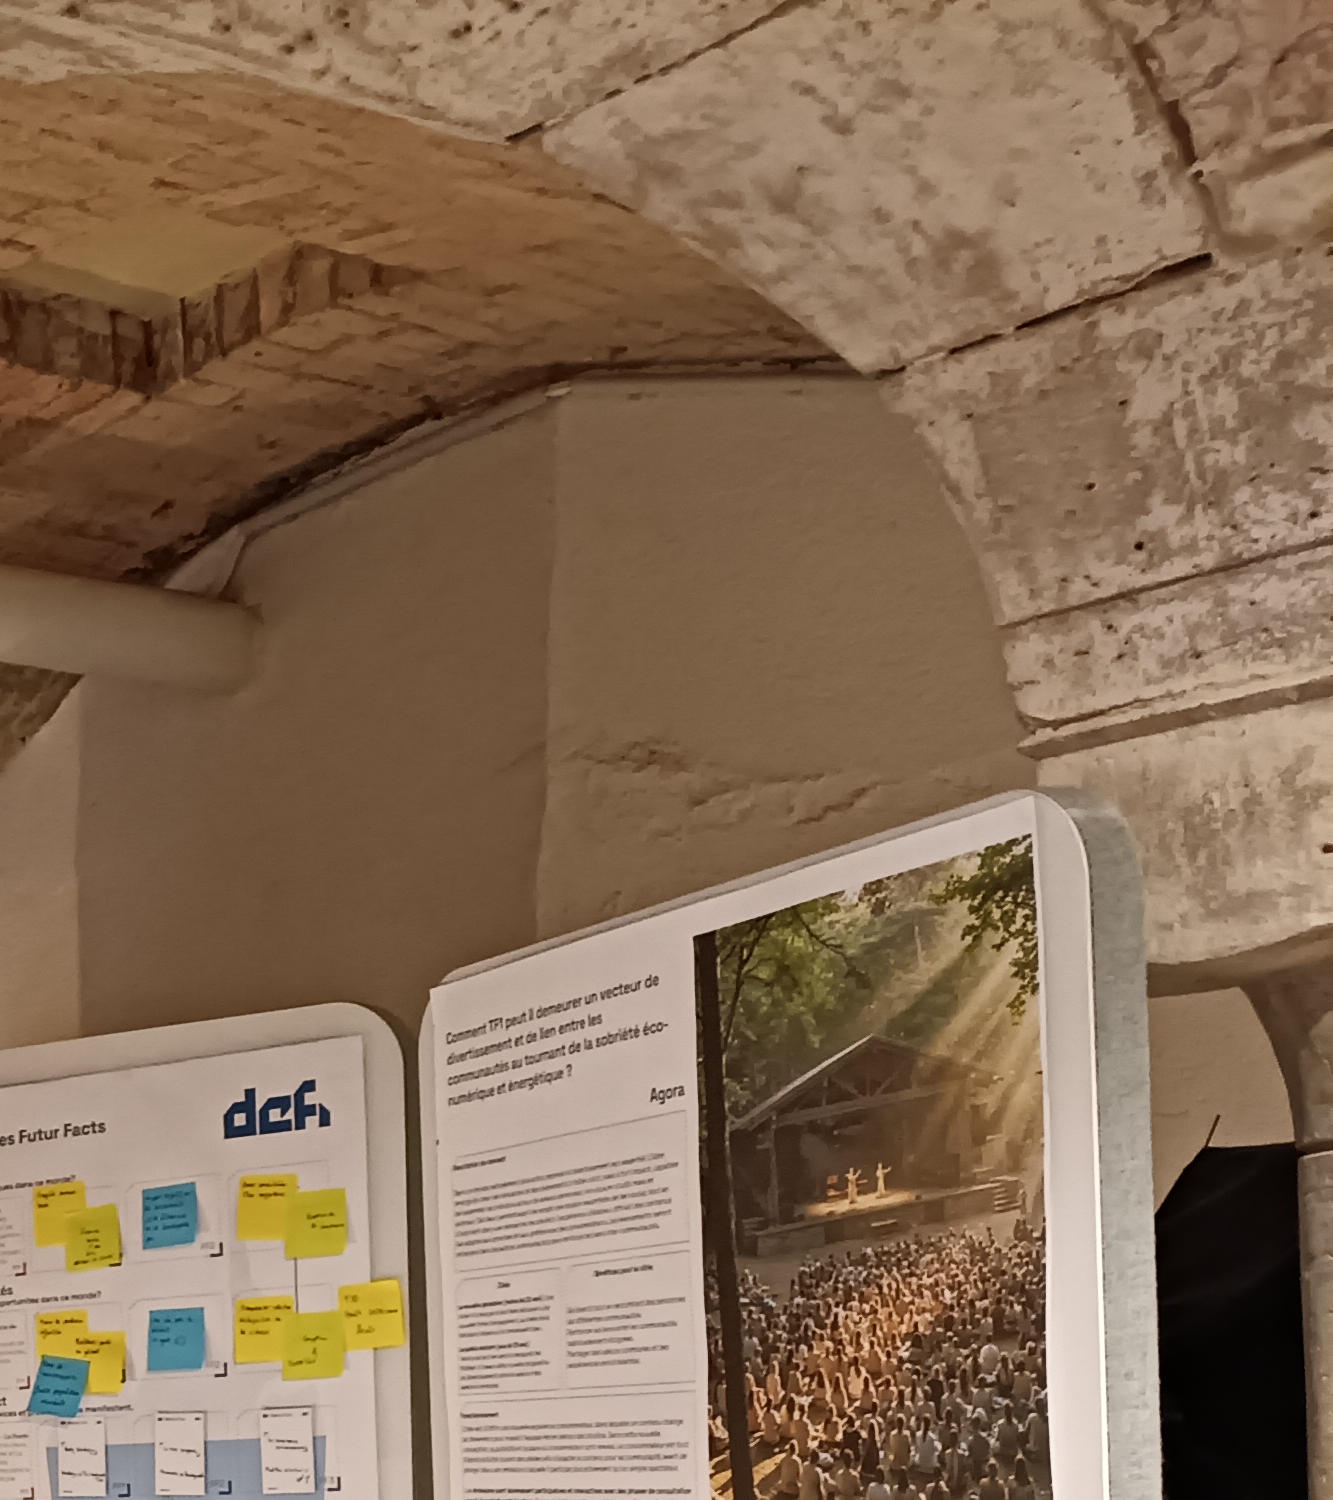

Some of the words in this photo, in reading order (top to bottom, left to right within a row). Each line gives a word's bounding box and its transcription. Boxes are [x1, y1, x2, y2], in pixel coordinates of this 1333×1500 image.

[446, 1023, 487, 1045] Comment
[505, 1011, 527, 1031] peut
[536, 997, 582, 1019] demeurer
[584, 993, 598, 1005] un
[599, 980, 642, 1000] vecteur
[644, 974, 660, 989] de
[514, 1035, 524, 1047] et
[526, 1031, 537, 1044] de
[539, 1026, 556, 1040] lien
[558, 1018, 586, 1035] entre
[588, 1013, 603, 1027] les
[448, 1060, 510, 1086] communautés
[511, 1059, 523, 1070] au
[524, 1045, 566, 1066] tournant
[568, 1040, 581, 1055] de
[583, 1038, 593, 1050] la
[595, 1024, 641, 1048] sobriété
[643, 1021, 669, 1036] éco-
[448, 1086, 495, 1106] numérique
[497, 1083, 507, 1095] et
[508, 1069, 564, 1091] énergétique
[566, 1063, 573, 1077] ?
[649, 1085, 686, 1105] Agora
[18, 1127, 60, 1144] Futur
[63, 1120, 107, 1137] Facts
